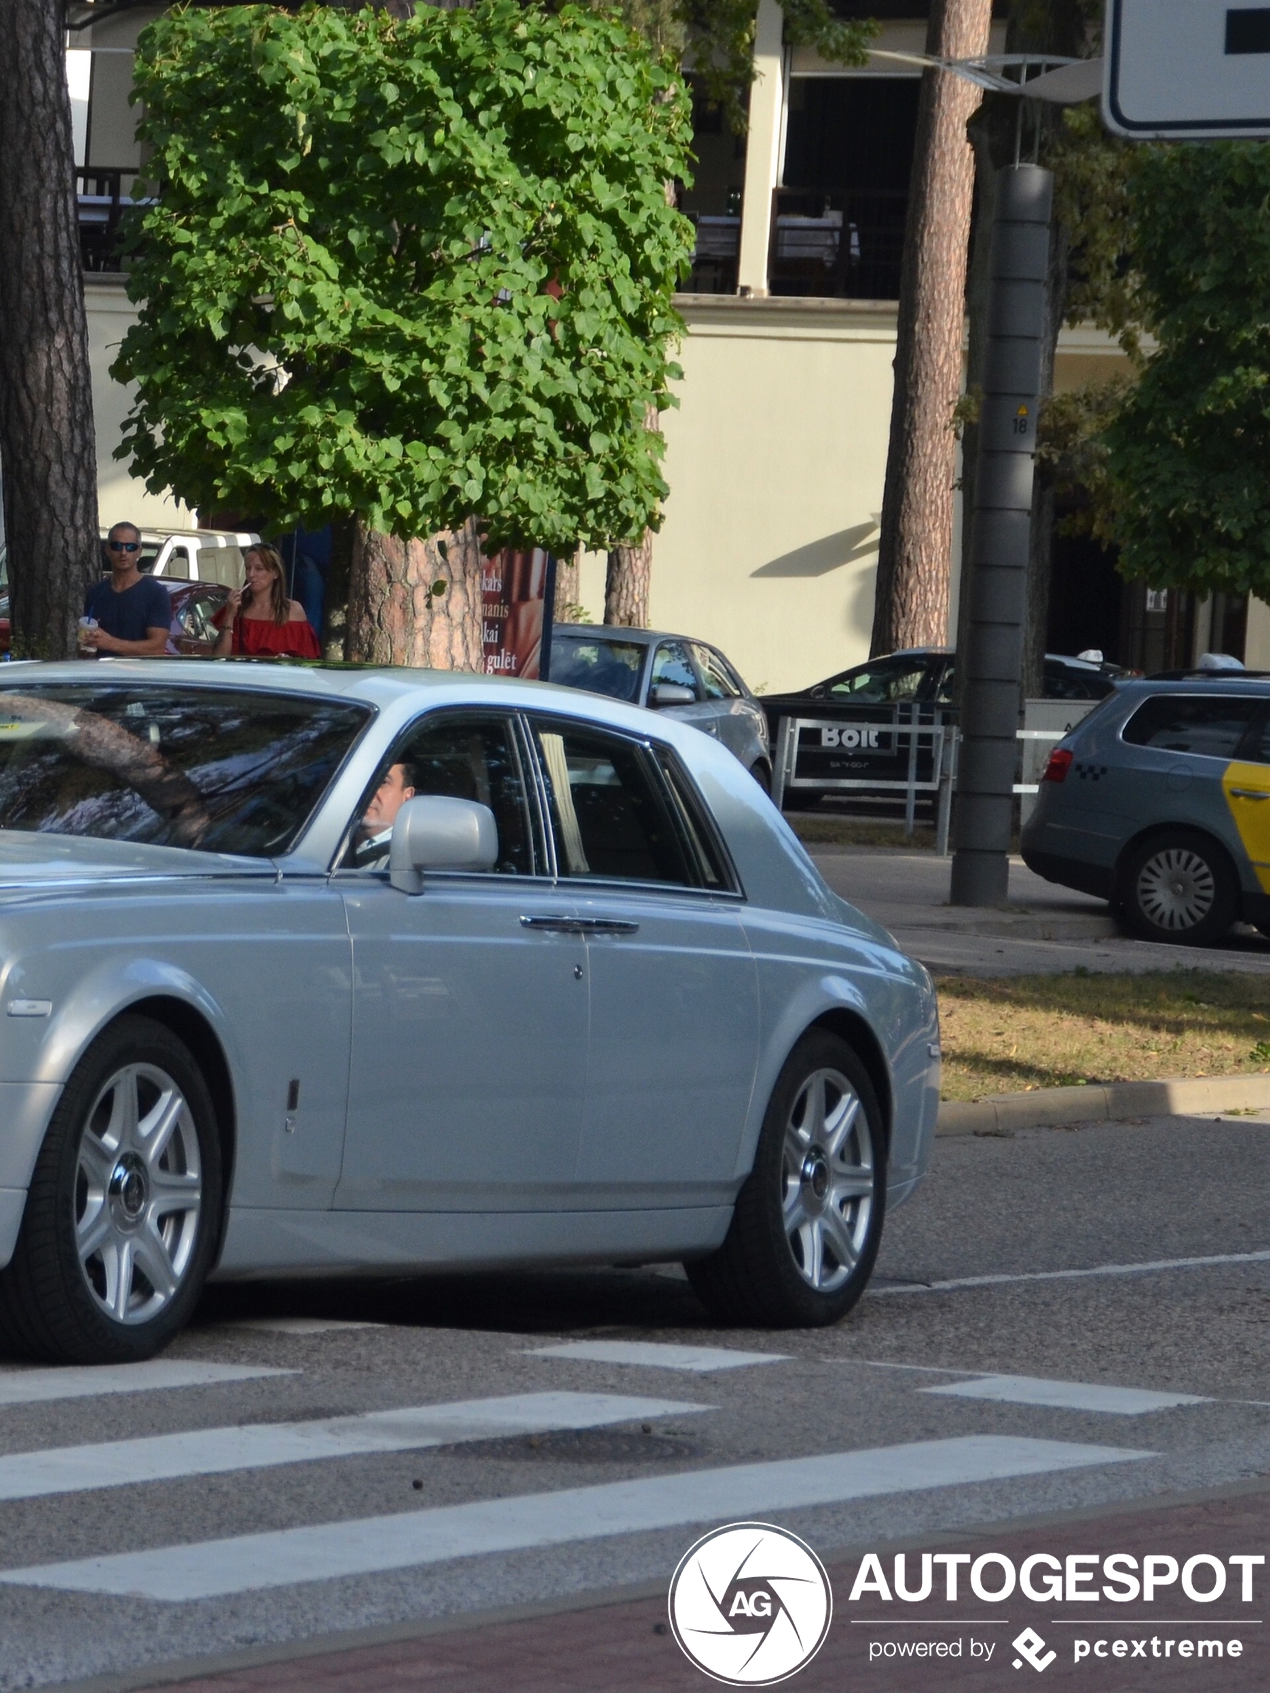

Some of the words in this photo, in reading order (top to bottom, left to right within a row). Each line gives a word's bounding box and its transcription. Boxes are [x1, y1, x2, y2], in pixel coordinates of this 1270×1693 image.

[1012, 418, 1028, 435] 18
[482, 569, 503, 592] kars
[482, 621, 499, 643] kai
[486, 648, 517, 675] gulēt
[821, 727, 879, 748] Bolt
